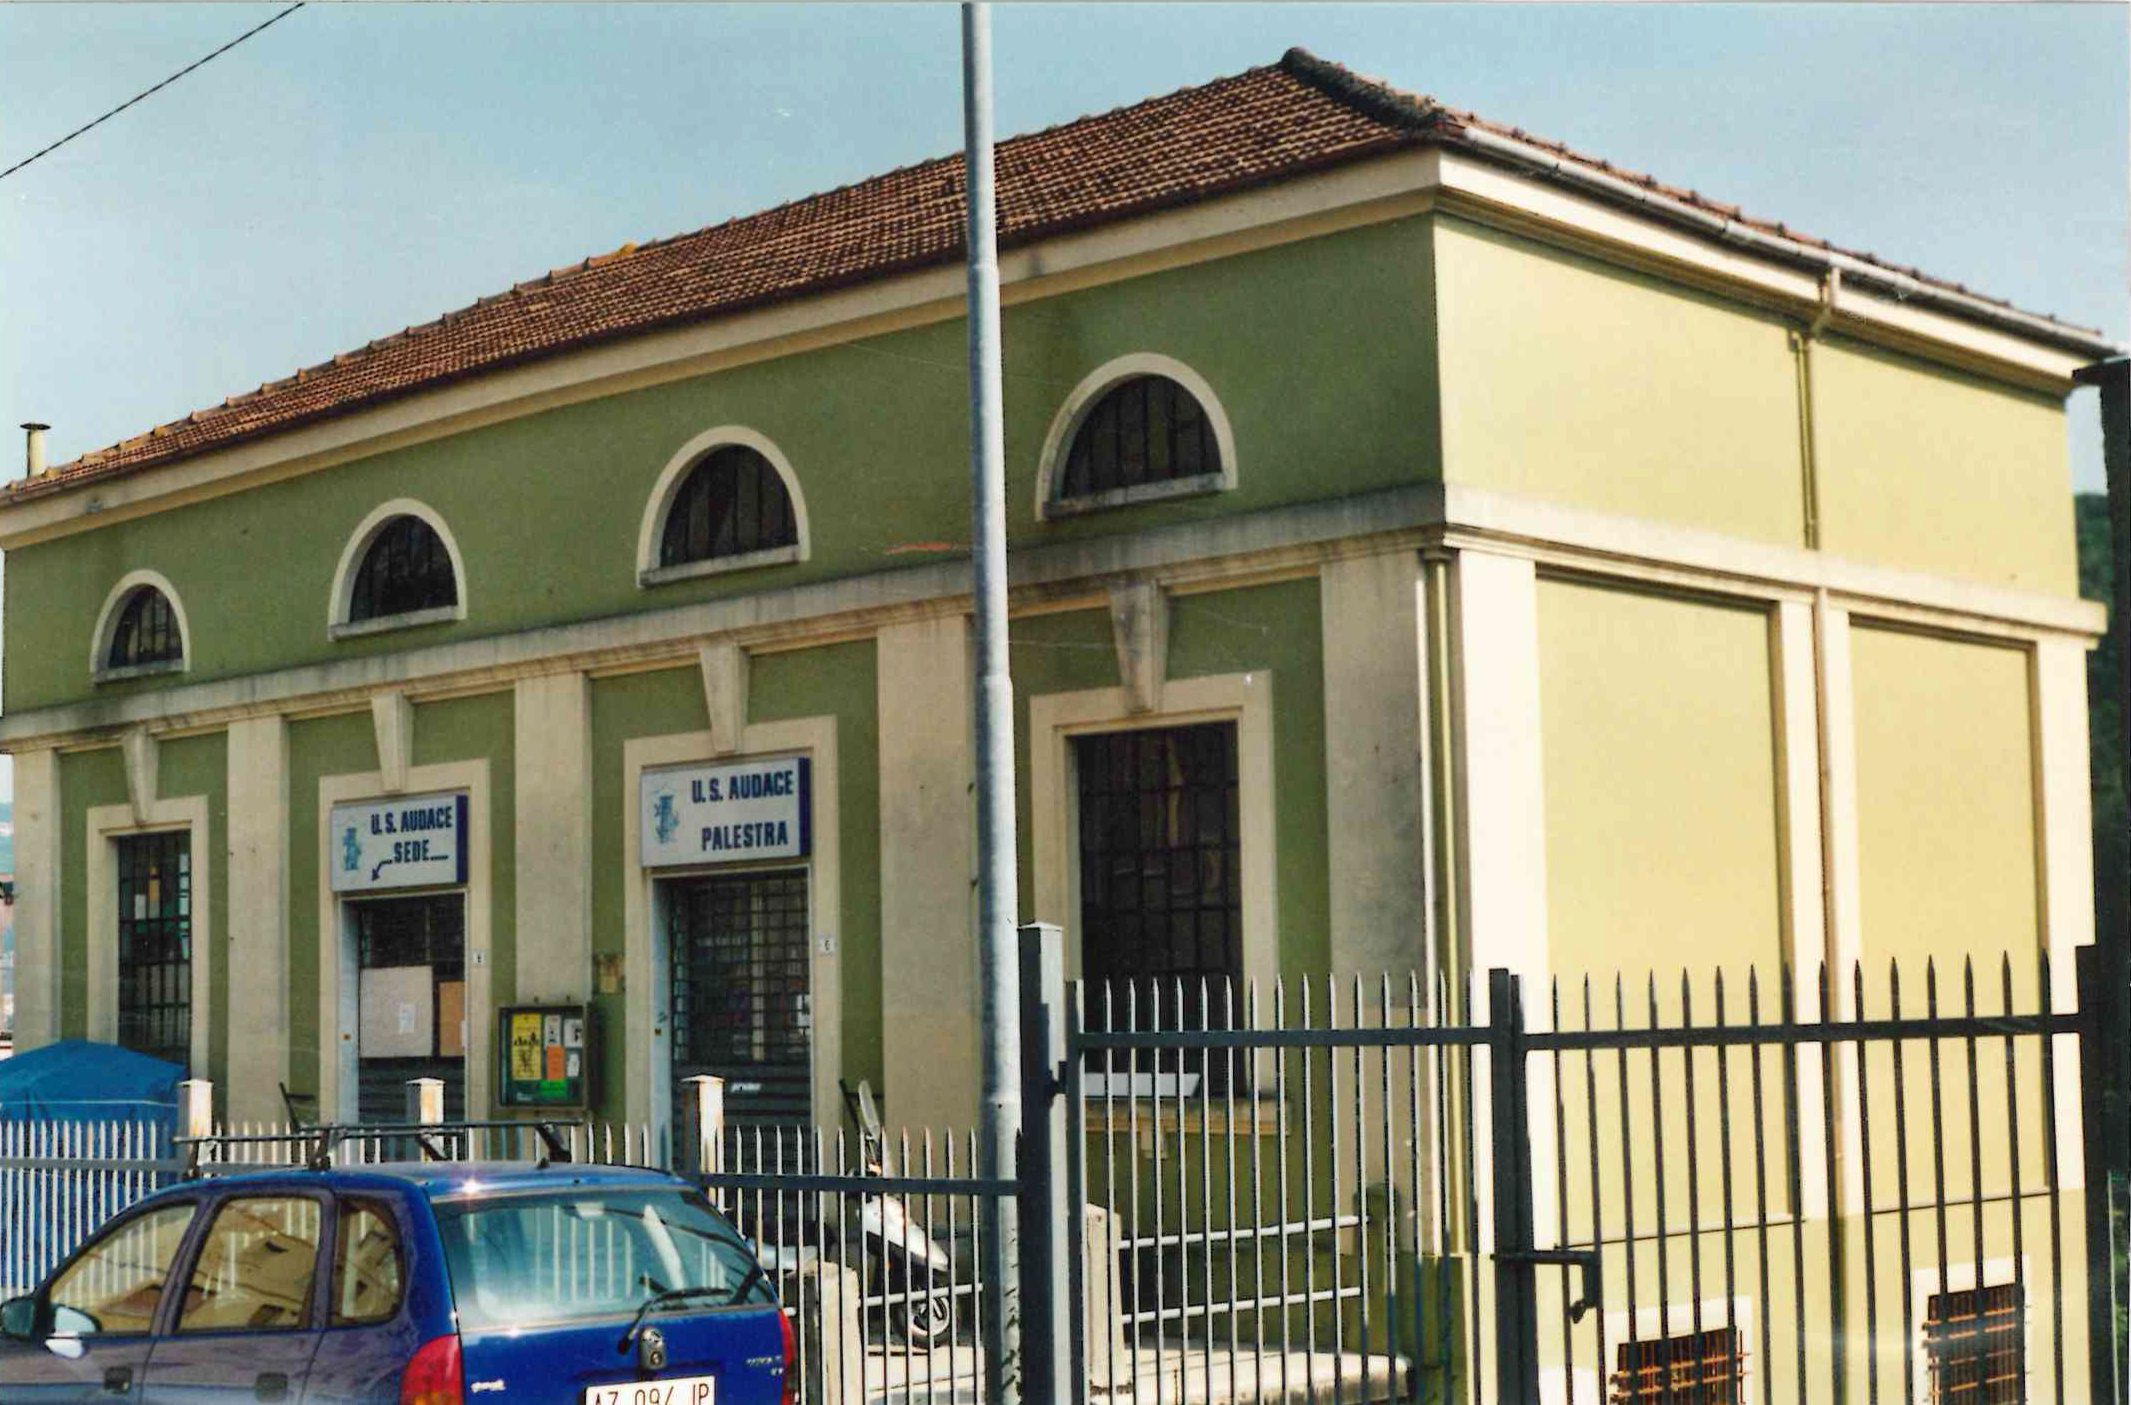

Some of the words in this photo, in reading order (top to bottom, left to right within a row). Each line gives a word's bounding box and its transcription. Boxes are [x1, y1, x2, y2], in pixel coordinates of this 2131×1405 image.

[729, 770, 793, 800] AUDACE
[401, 806, 453, 832] AUDACE
[702, 821, 788, 851] PALESTRA
[394, 839, 430, 863] SEDE
